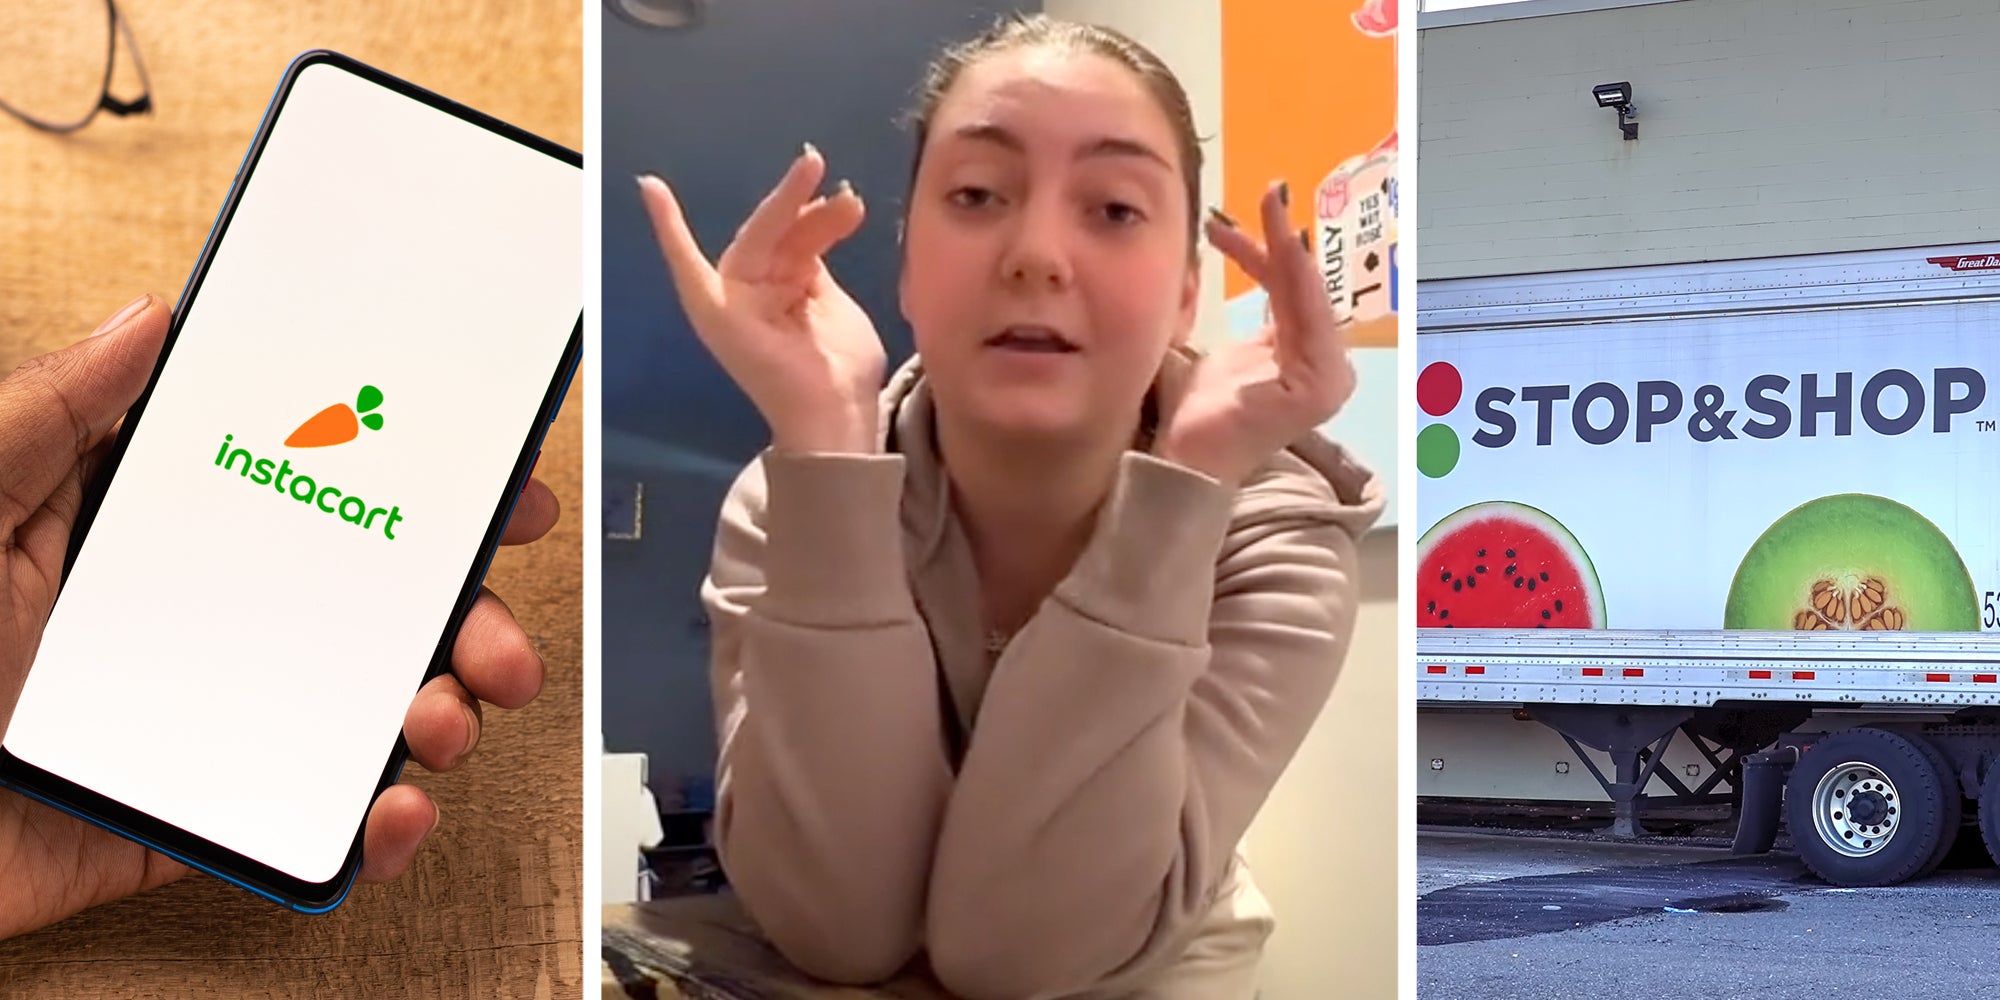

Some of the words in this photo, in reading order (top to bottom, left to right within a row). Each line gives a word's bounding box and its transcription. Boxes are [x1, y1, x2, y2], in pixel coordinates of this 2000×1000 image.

[1359, 193, 1380, 213] YES
[1957, 257, 1986, 269] Great
[1985, 255, 2000, 267] Da
[1471, 367, 1987, 449] STOP&SHOP
[1975, 420, 1996, 432] TM
[214, 433, 404, 541] instacart
